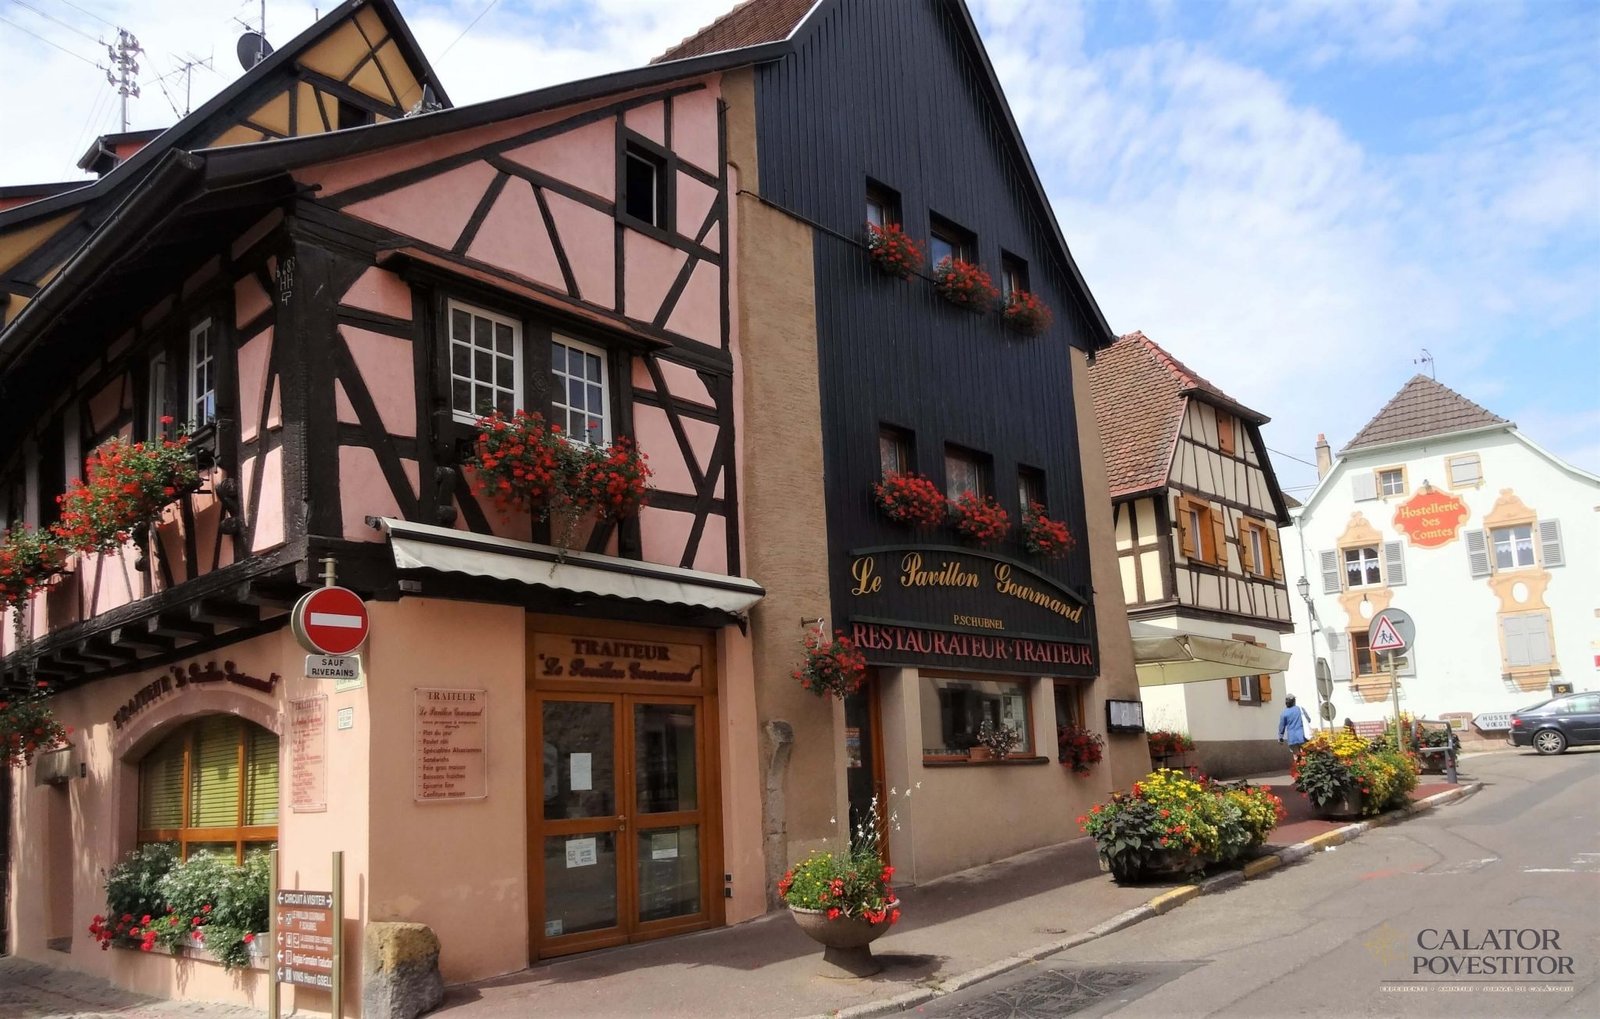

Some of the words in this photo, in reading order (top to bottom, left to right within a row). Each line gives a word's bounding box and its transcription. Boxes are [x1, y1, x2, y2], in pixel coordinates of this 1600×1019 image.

[1400, 502, 1459, 518] Hostellerie
[1421, 517, 1440, 527] des
[1411, 528, 1453, 540] Comtes
[851, 556, 882, 596] Le
[900, 551, 980, 588] Pavillon
[994, 562, 1083, 623] Gourmand
[571, 638, 671, 661] TRAITEUR
[852, 622, 1009, 659] RESTAURATEUR
[1012, 639, 1093, 665] TRAITEUR
[322, 658, 344, 667] SAUF
[311, 668, 354, 677] RIVERAINS
[428, 691, 476, 701] TRAITEUR
[284, 893, 303, 904] CIRCUIT
[307, 894, 326, 906] VISITER
[292, 970, 303, 982] VINS
